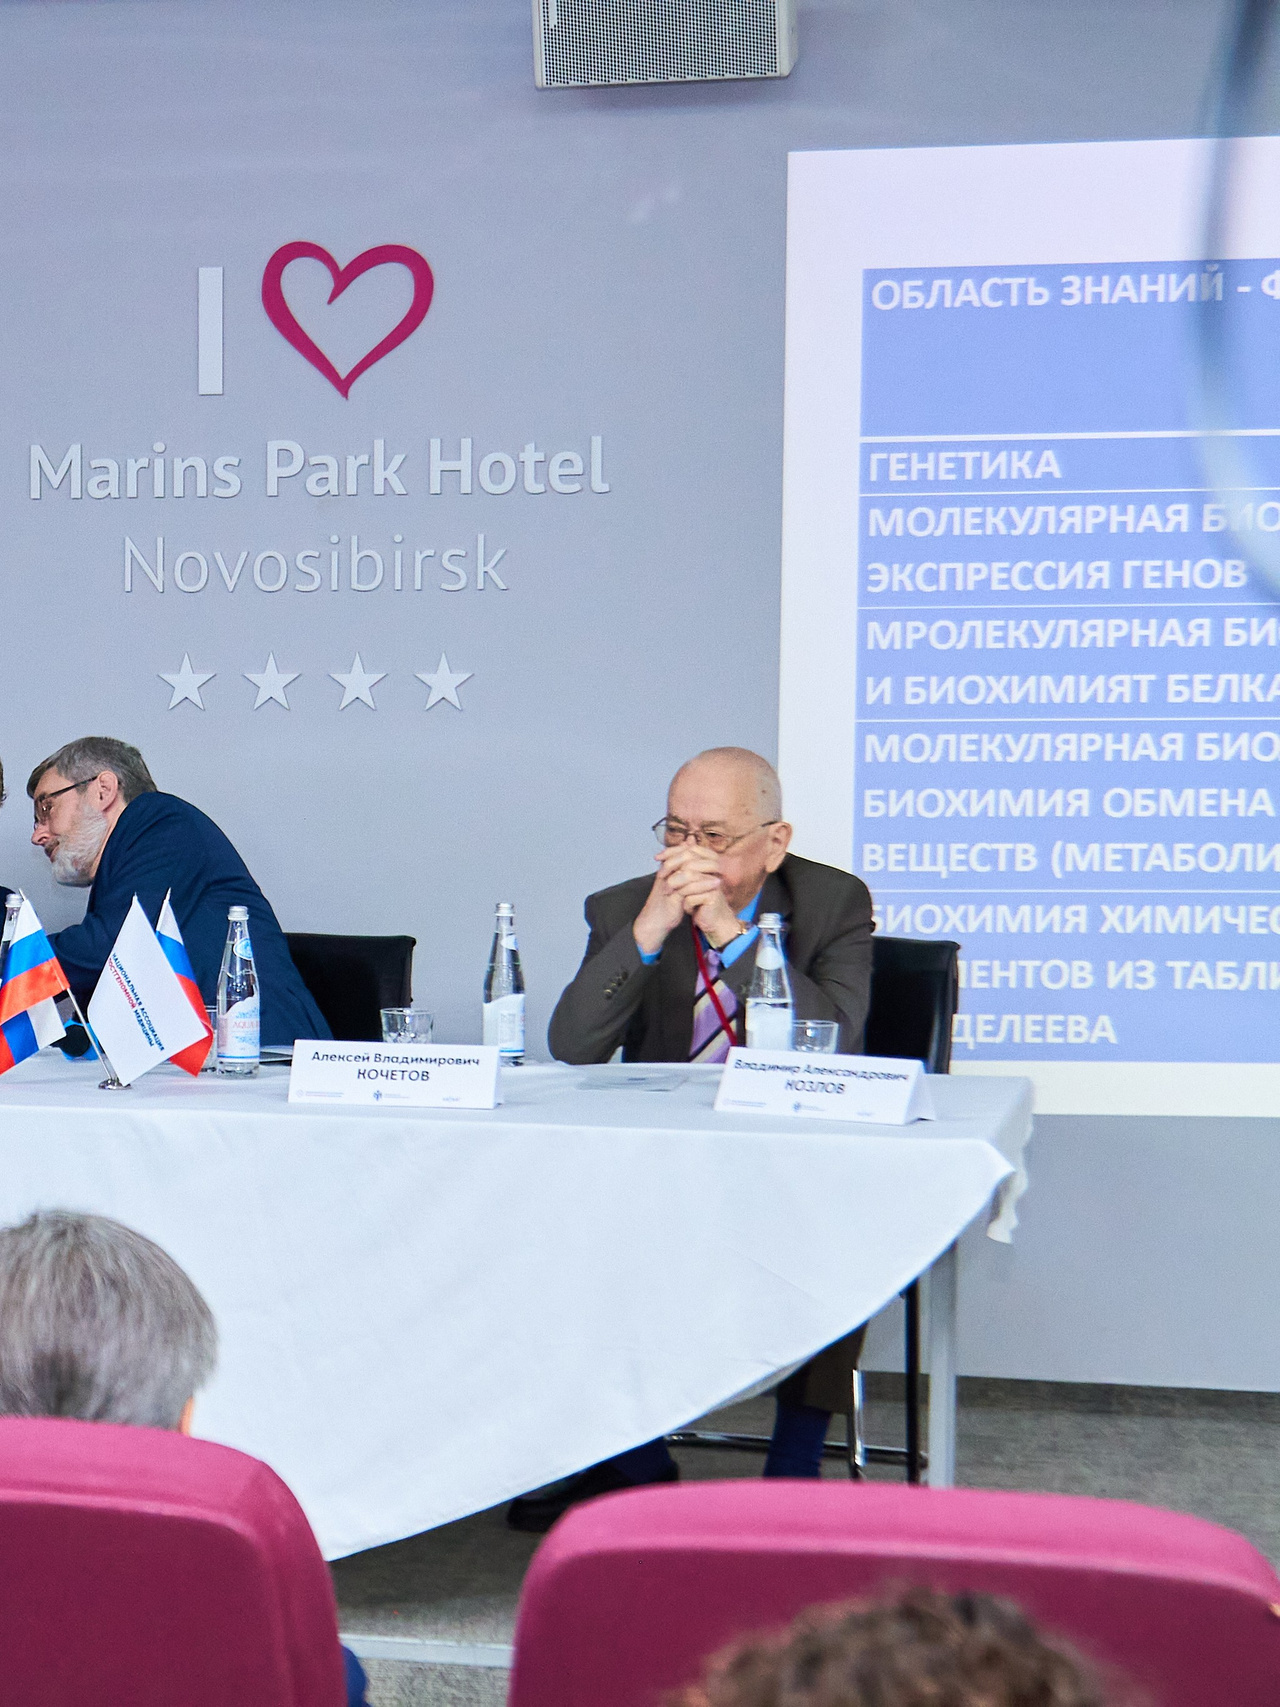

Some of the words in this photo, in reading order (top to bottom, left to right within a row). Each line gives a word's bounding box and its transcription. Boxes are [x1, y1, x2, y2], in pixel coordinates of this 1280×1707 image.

[871, 277, 1051, 312] ОБЛАСТЬ
[1061, 263, 1224, 308] ЗНАНИЙ
[198, 266, 224, 396] I
[29, 441, 242, 500] Marins
[265, 438, 408, 497] Park
[428, 435, 611, 496] Hotel
[869, 449, 1063, 483] ГЕНЕТИКА
[869, 503, 1190, 538] МОЛЕКУЛЯРНАЯ
[123, 533, 509, 594] Novosibirsk
[867, 560, 1112, 594] ЭКСПРЕССИЯ
[1123, 558, 1249, 590] ГЕНОВ
[867, 618, 1212, 651] МРОЛЕКУЛЯРНАЯ
[1223, 617, 1280, 648] БИ
[866, 676, 893, 707] И
[904, 674, 1159, 706] БИОХИМИЯТ
[864, 732, 1185, 765] МОЛЕКУЛЯРНАЯ
[1196, 731, 1280, 763] БИО
[863, 788, 1091, 820] БИОХИМИЯ
[1102, 787, 1277, 820] ОБМЕНА
[862, 842, 1039, 880] ВЕЩЕСТВ
[1051, 841, 1280, 881] (МЕТАБОЛИ
[957, 960, 1095, 992] ЕНТОВ
[1106, 959, 1157, 992] ИЗ
[112, 952, 143, 1007] НАЦИОНАЛЬНАЯ
[140, 1007, 165, 1051] АССОЦИАЦИЯ
[311, 1051, 370, 1064] Алексей
[374, 1053, 480, 1067] Владимирович
[357, 1068, 430, 1082] КОЧЕТОВ
[734, 1059, 801, 1076] Владимир
[803, 1064, 910, 1082] Александрович
[785, 1079, 846, 1095] КОЗЛОВ
